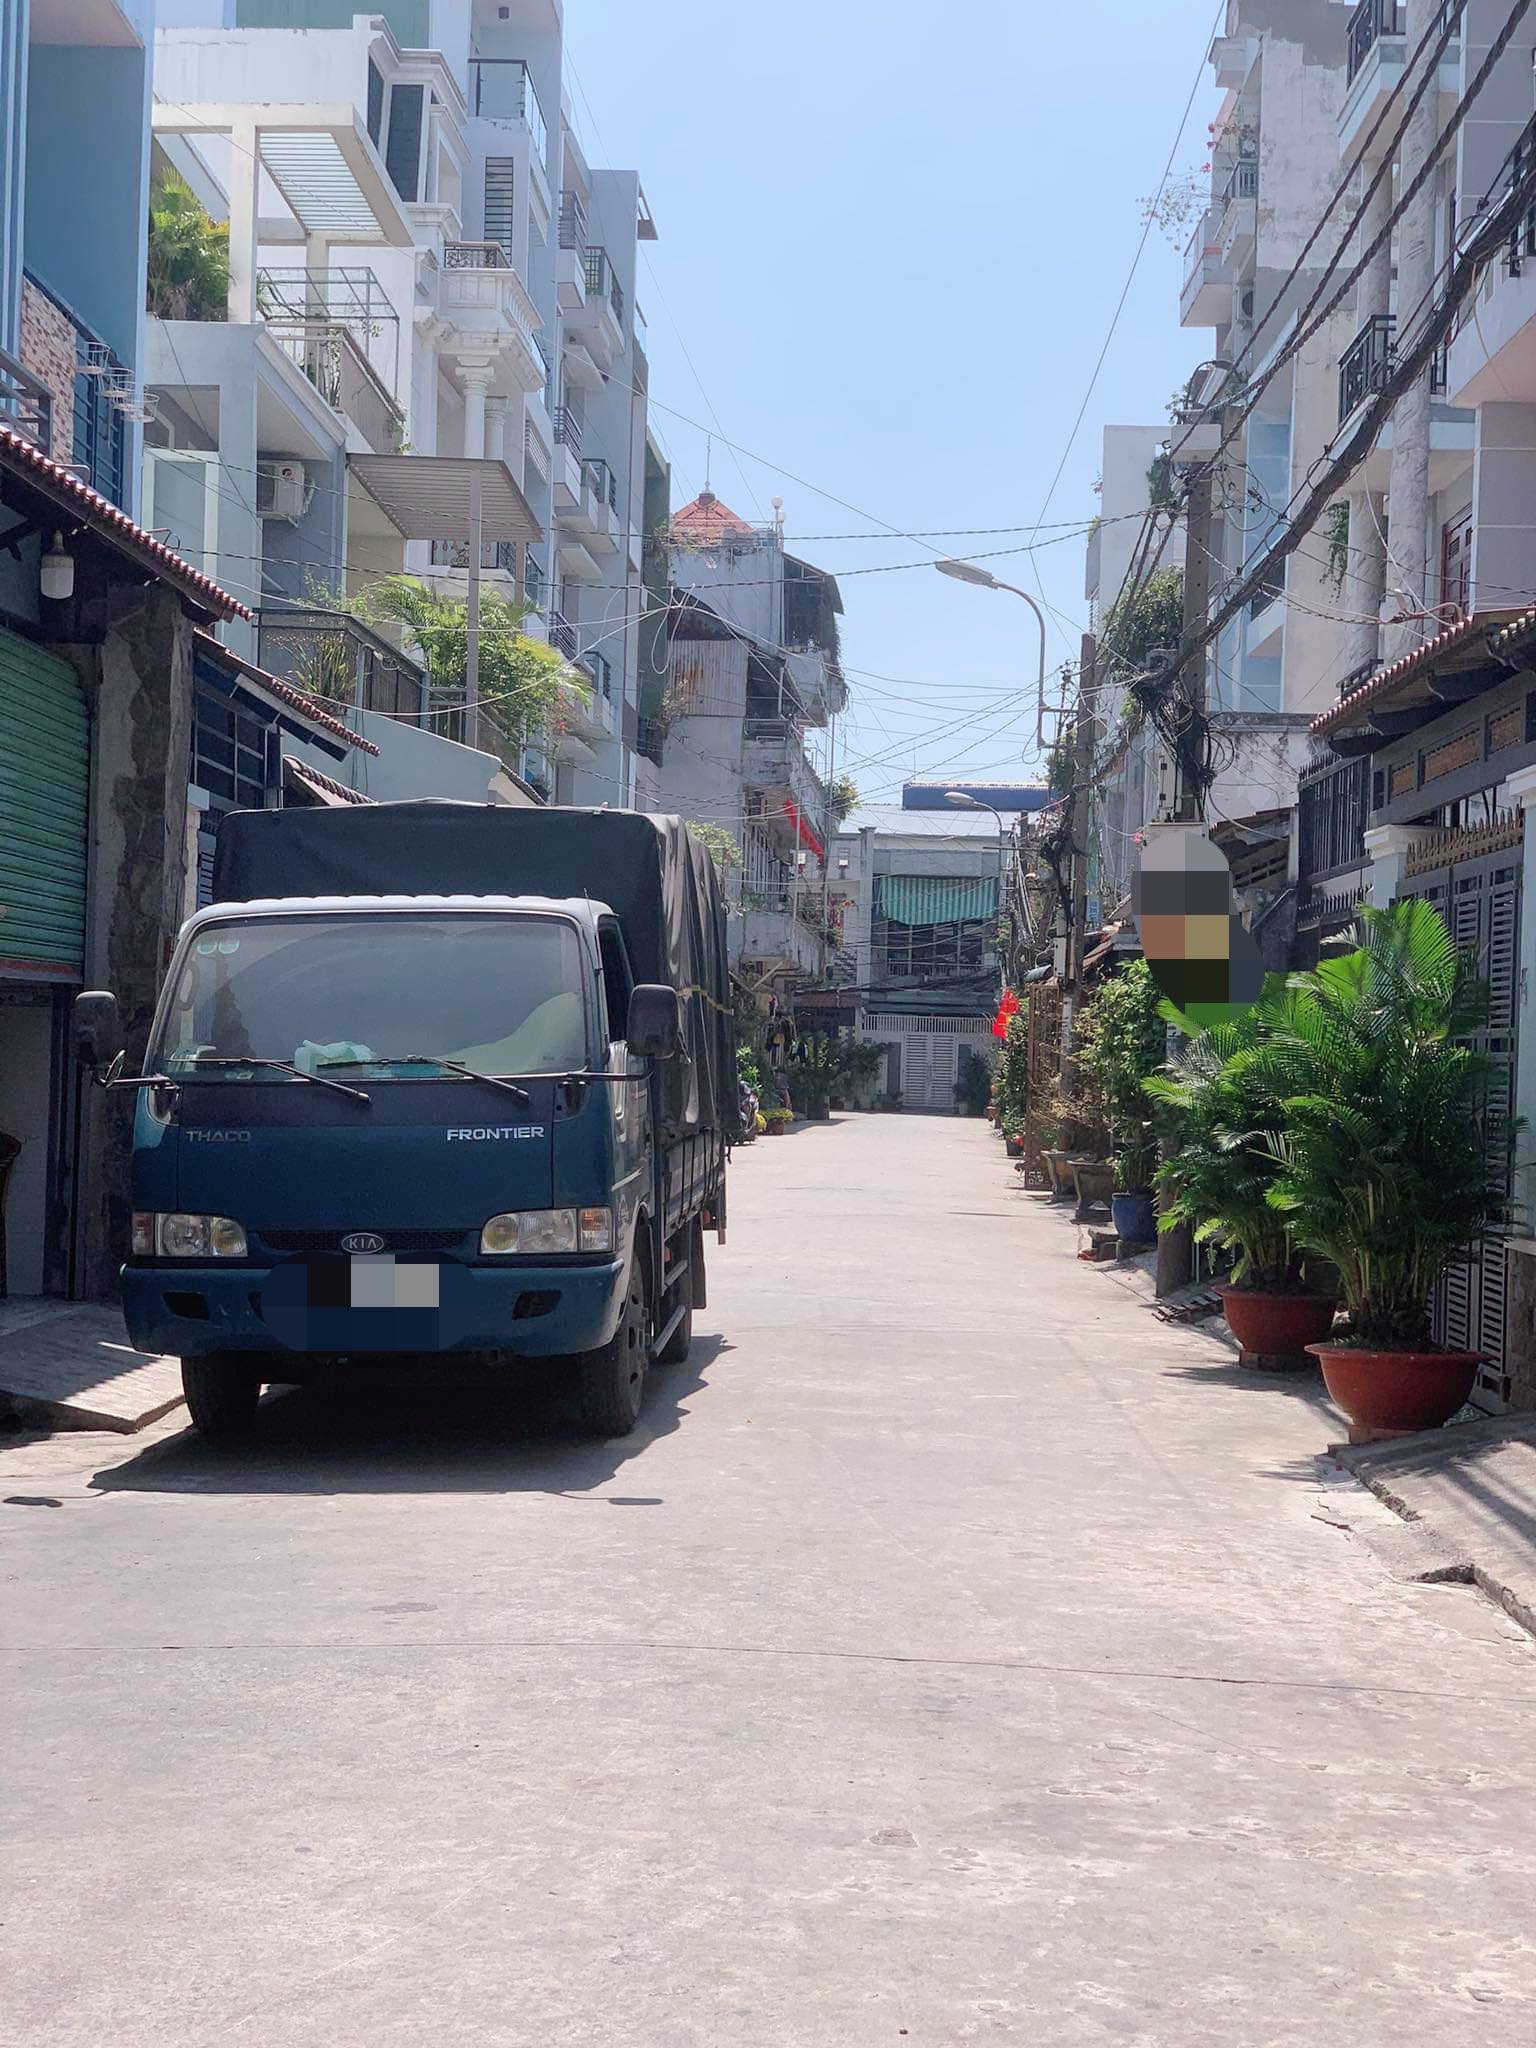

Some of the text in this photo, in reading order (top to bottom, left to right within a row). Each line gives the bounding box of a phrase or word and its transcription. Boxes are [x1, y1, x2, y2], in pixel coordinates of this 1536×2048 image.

[186, 1129, 251, 1142] THACO
[446, 1126, 545, 1141] FRONTIER
[349, 1237, 378, 1249] KIA
